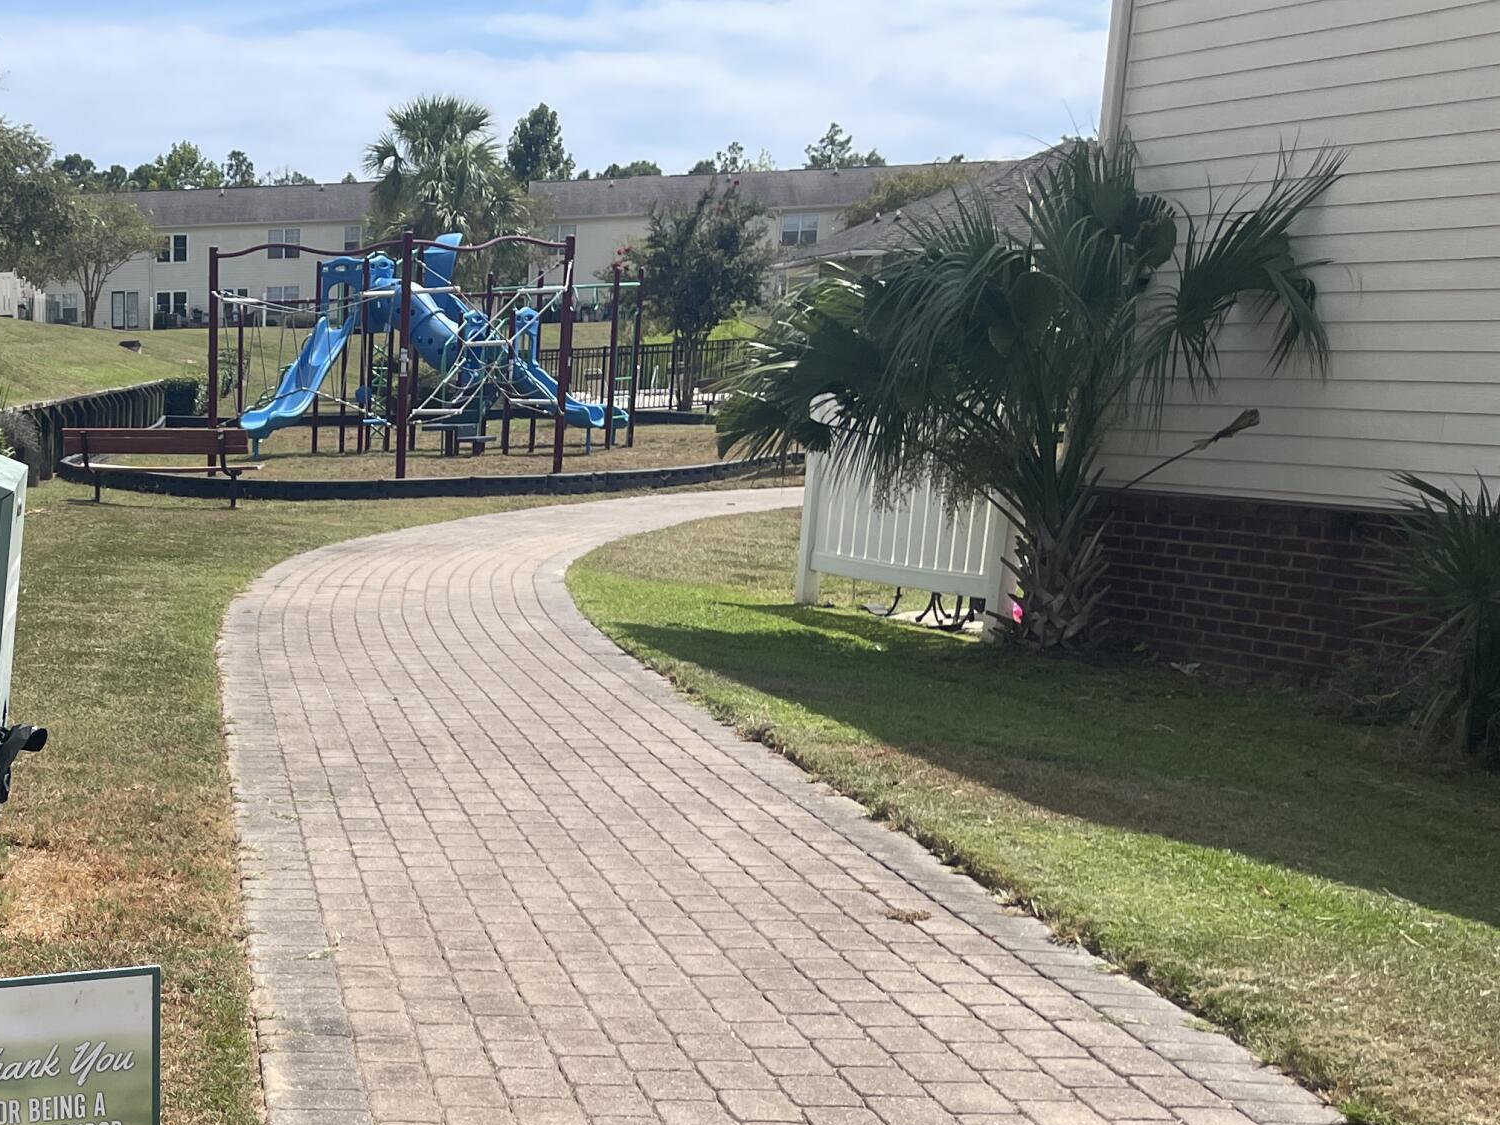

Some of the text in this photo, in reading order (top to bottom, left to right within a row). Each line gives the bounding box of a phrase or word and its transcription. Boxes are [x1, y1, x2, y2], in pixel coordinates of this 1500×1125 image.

[69, 1041, 135, 1086] You
[29, 1094, 86, 1121] BEING
[93, 1092, 106, 1117] A
